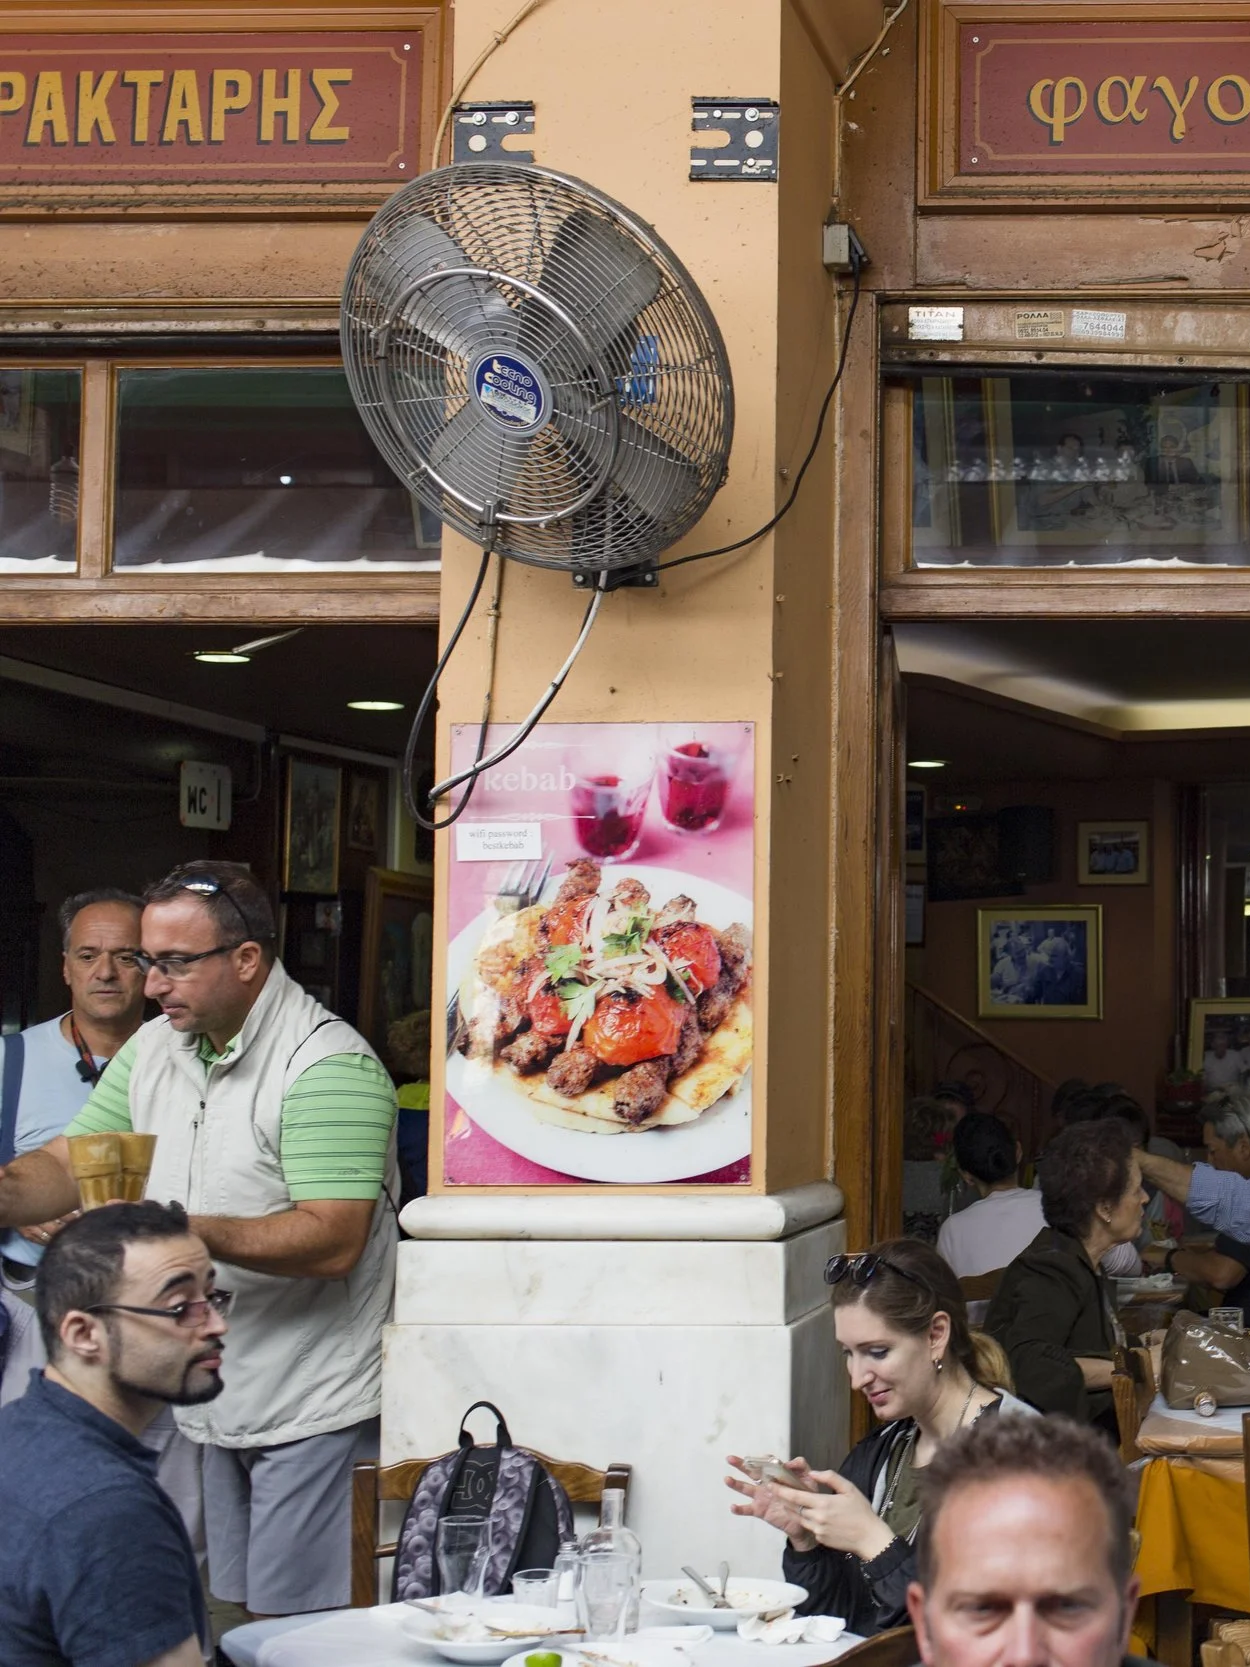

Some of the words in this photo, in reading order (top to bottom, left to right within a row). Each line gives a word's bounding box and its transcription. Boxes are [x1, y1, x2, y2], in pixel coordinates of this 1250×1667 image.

[1083, 322, 1124, 332] 7644044
[483, 764, 577, 792] kebab
[187, 785, 208, 815] WC
[468, 828, 486, 839] wifi
[487, 828, 529, 841] password
[482, 840, 525, 850] bestkebab
